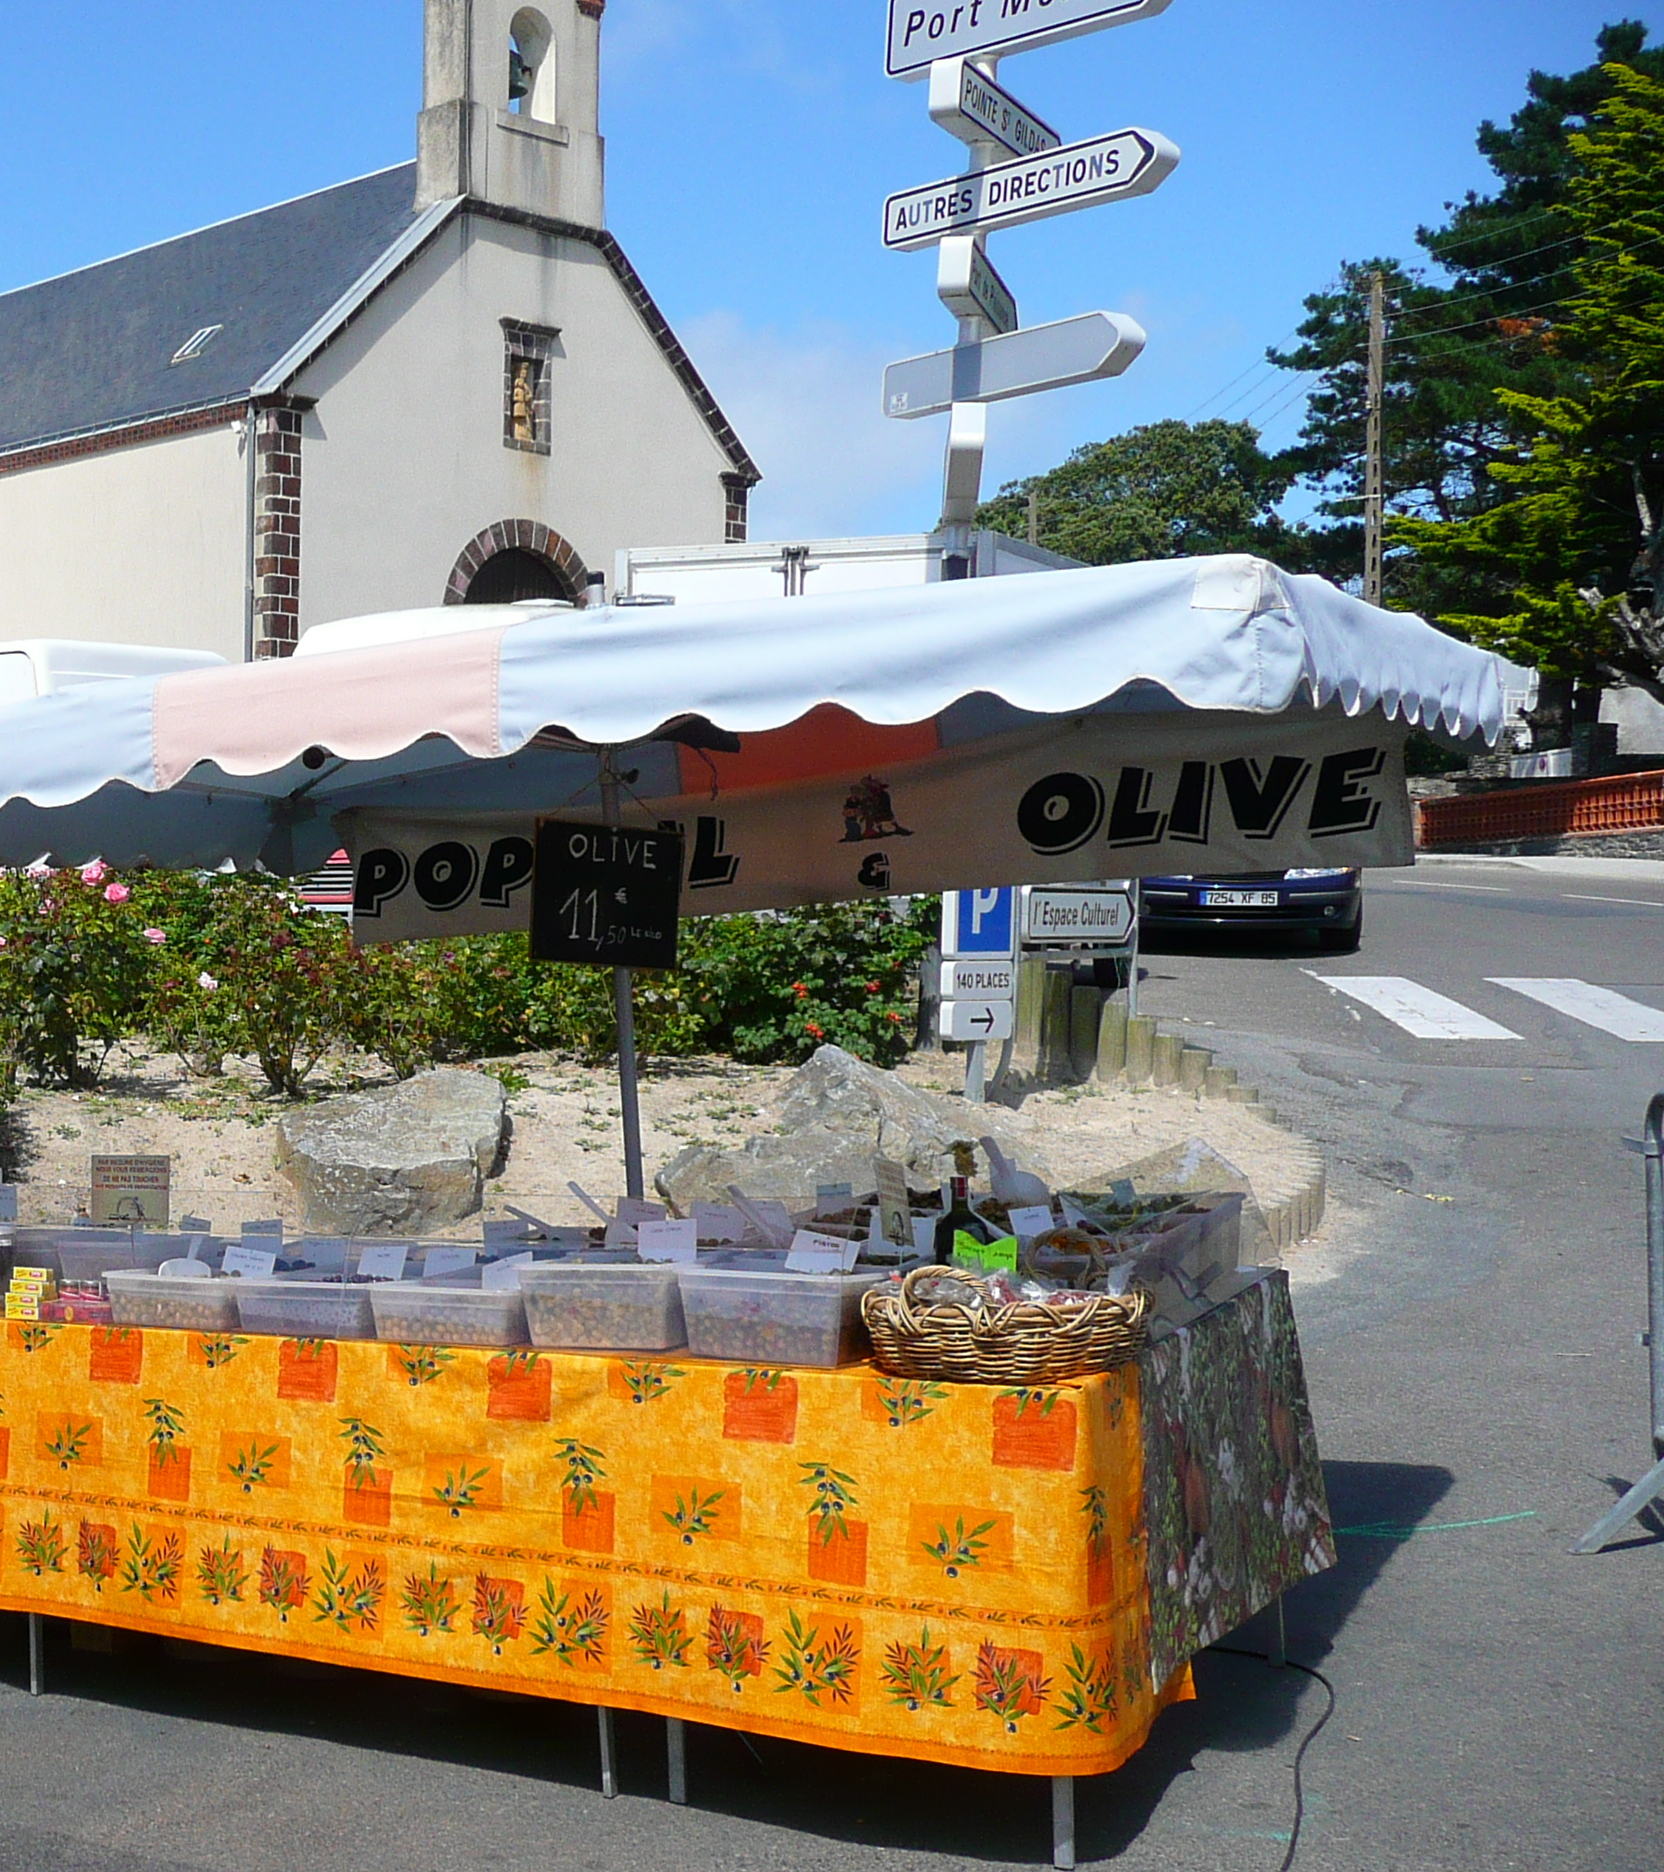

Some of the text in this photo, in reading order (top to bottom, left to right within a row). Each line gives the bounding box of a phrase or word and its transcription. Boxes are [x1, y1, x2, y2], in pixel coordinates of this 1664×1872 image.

[903, 0, 981, 47] Port
[964, 78, 998, 124] POINTE
[895, 149, 1120, 231] AUTRES DIRECTIONS
[1017, 746, 1386, 856] OLIVE
[569, 827, 657, 869] OLIVE
[972, 887, 998, 934] P
[1081, 901, 1120, 926] Culturel
[1207, 892, 1235, 904] 7254
[1241, 892, 1255, 904] XF
[956, 972, 1010, 989] 140 PLACES
